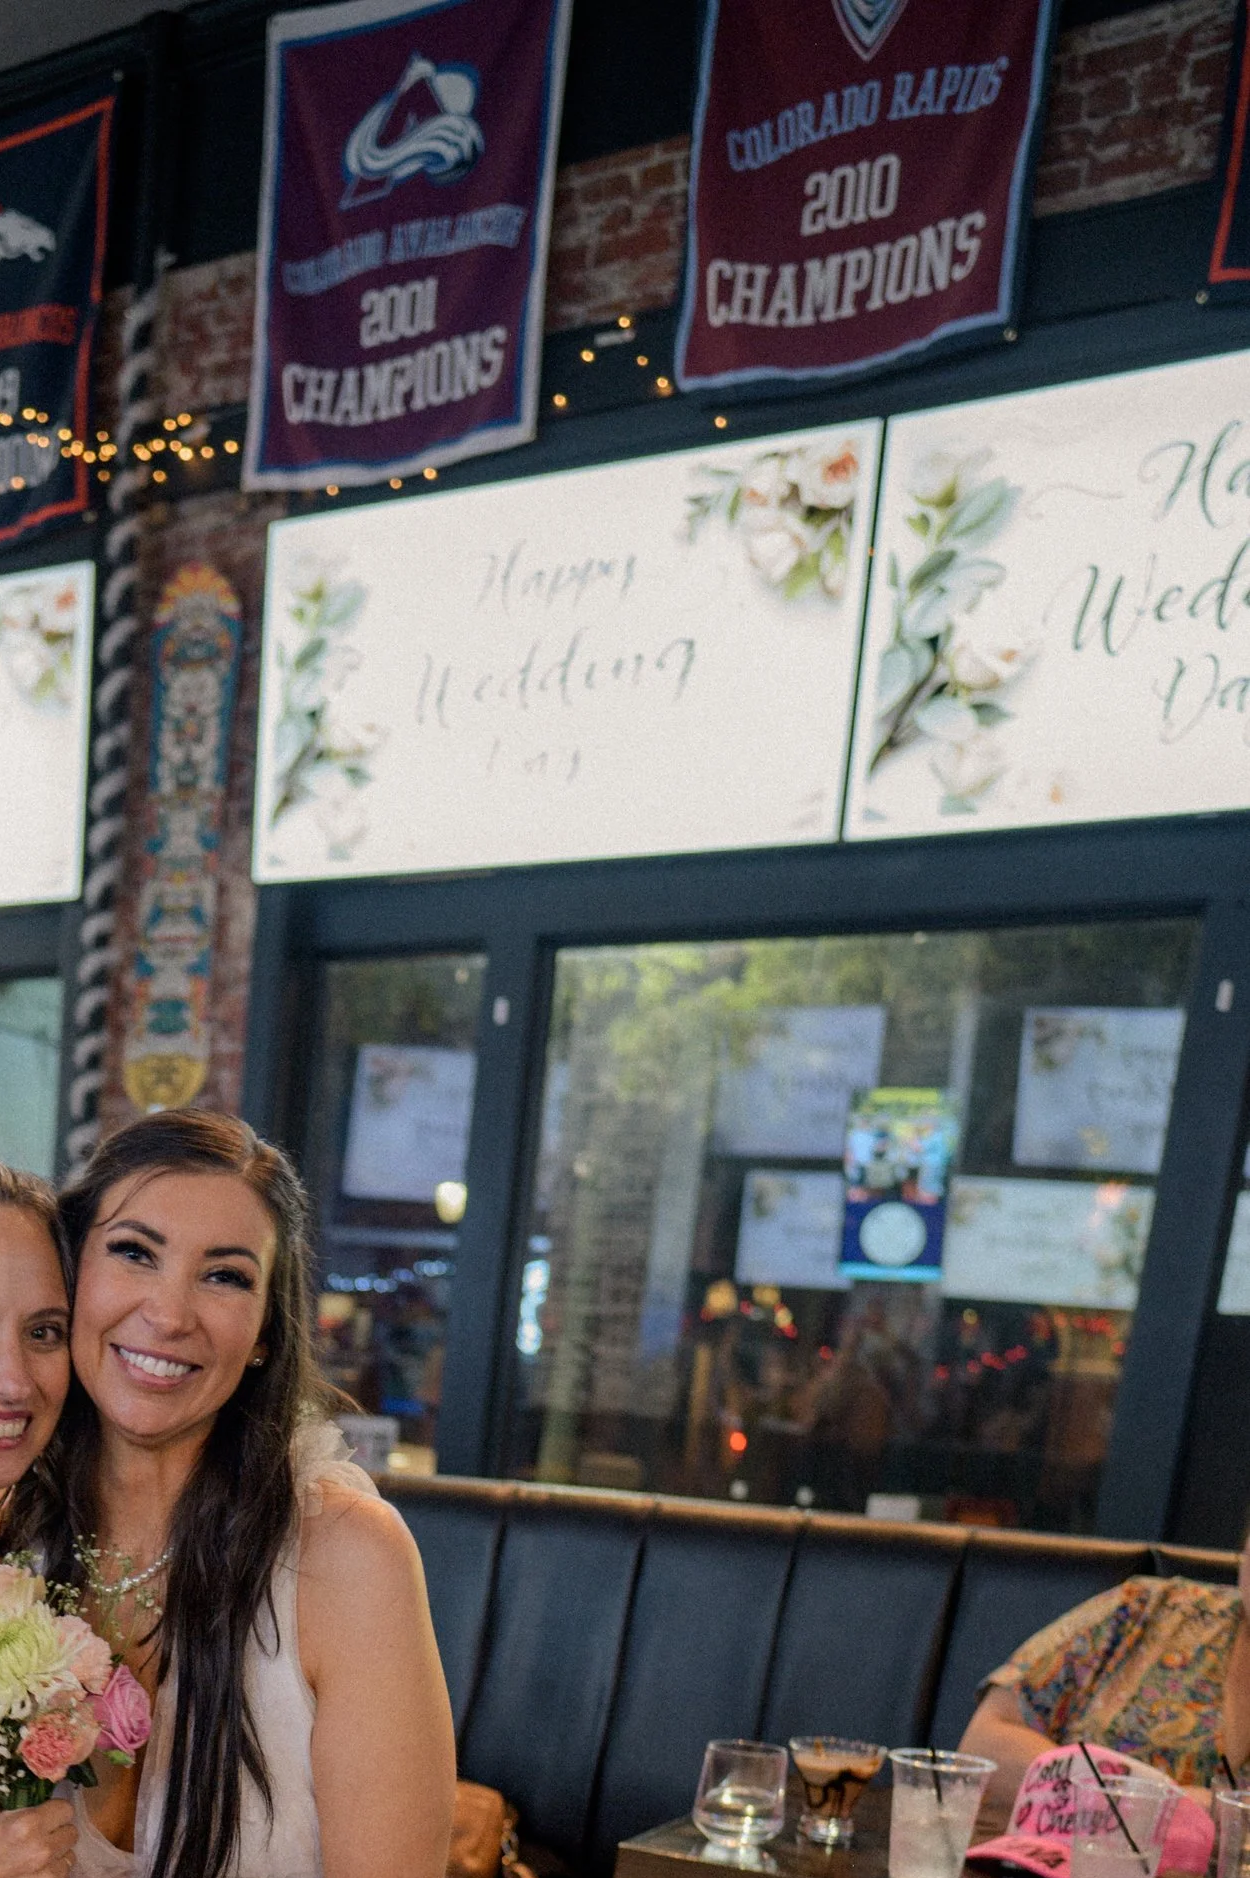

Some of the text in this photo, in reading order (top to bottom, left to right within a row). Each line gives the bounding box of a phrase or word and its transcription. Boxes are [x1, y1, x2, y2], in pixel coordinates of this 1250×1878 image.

[726, 55, 1011, 172] COLORADO RAPIDS
[799, 153, 901, 237] 2010
[358, 276, 440, 349] 2001
[705, 211, 988, 329] CHAMPIONS
[280, 324, 508, 427] CHAMPIONS
